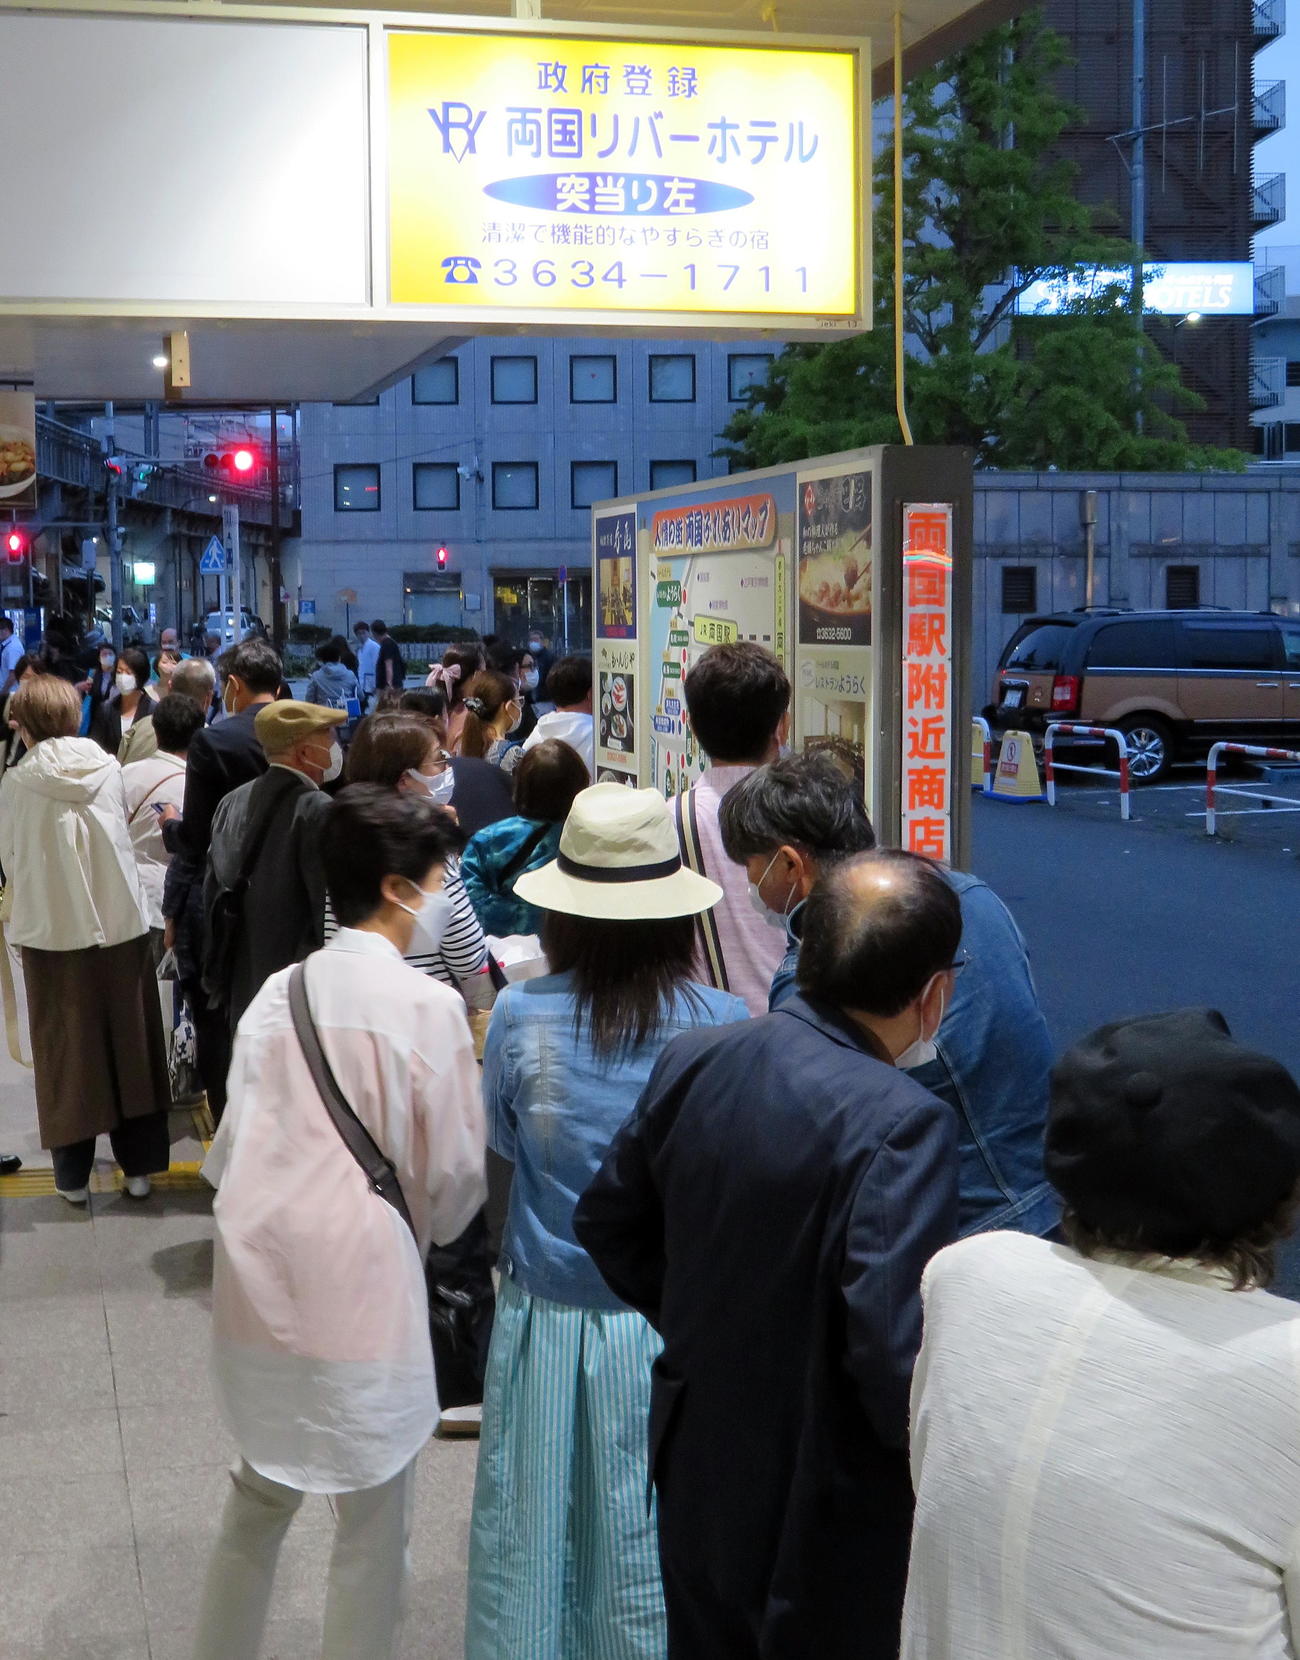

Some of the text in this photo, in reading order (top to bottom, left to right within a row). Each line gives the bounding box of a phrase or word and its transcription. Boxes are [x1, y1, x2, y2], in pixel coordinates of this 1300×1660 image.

[537, 61, 699, 98] 政府登録
[505, 106, 819, 164] 両国リバーホテル
[555, 174, 697, 214] 突当り左
[481, 222, 770, 251] 清潔で機能的なやすらぎの宿
[906, 511, 947, 861] 両国駅附近商店
